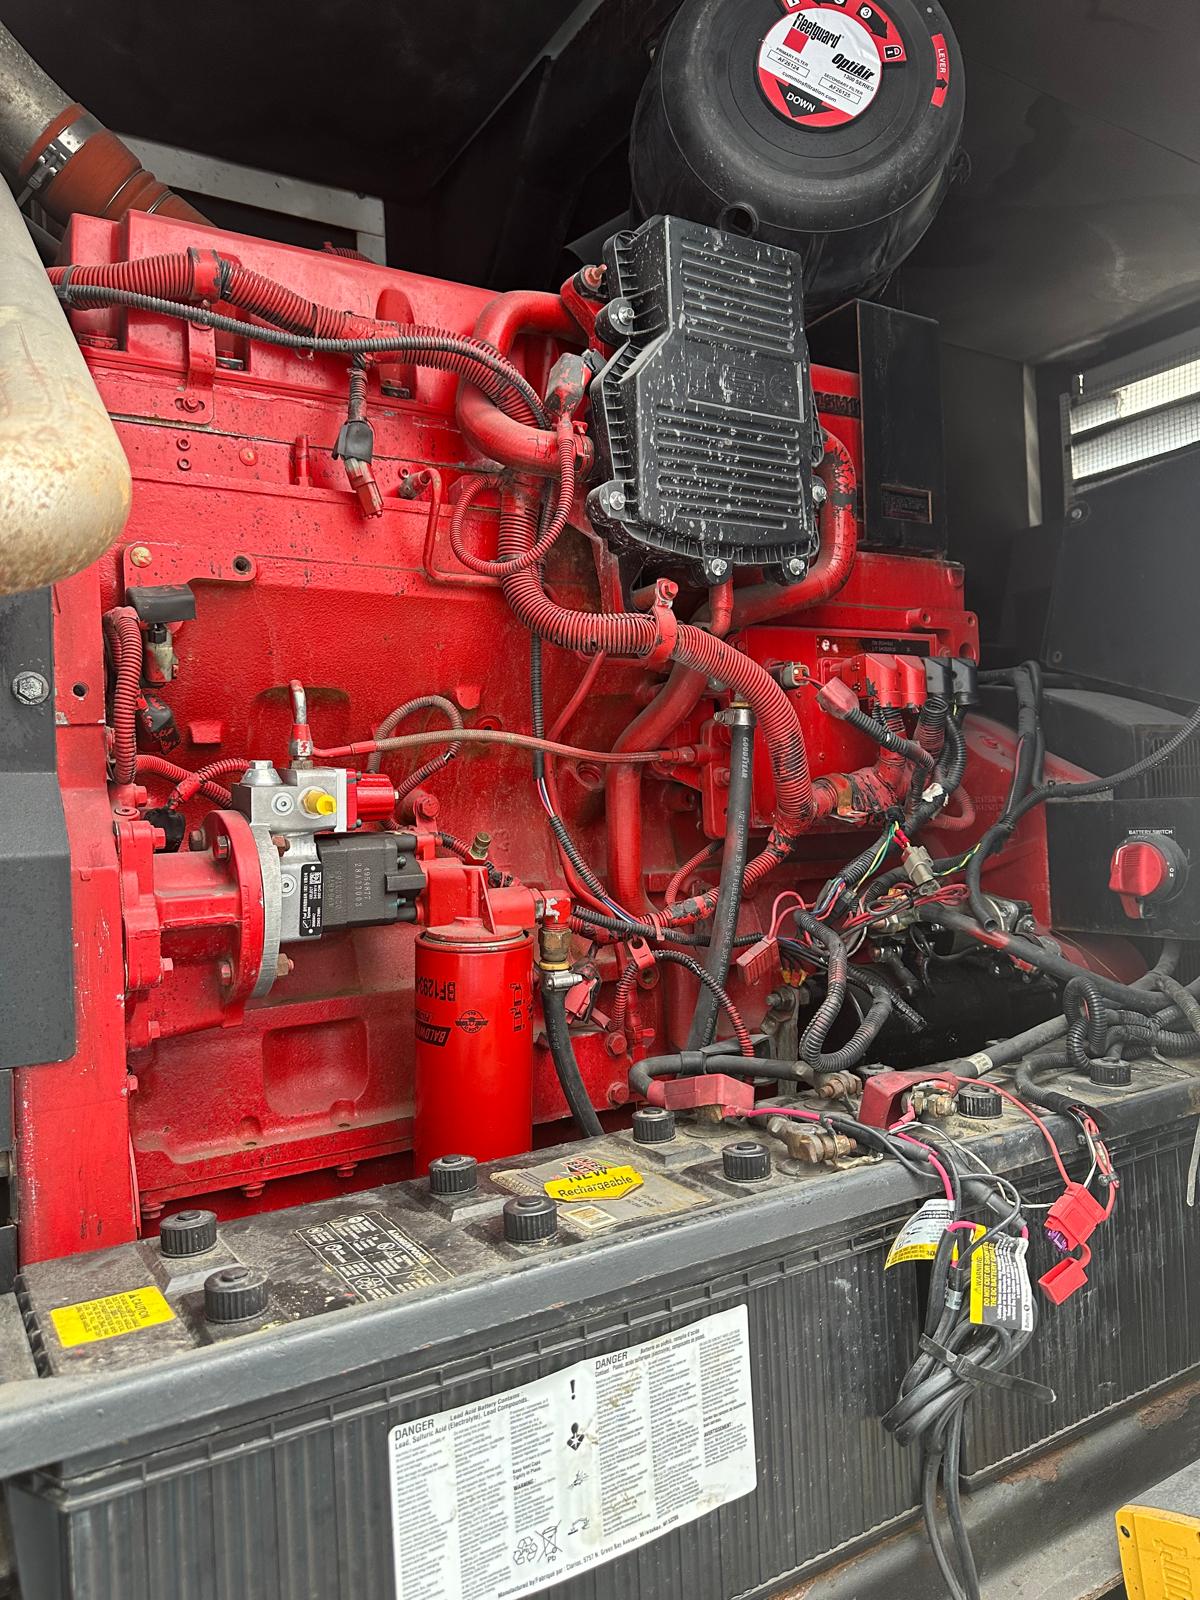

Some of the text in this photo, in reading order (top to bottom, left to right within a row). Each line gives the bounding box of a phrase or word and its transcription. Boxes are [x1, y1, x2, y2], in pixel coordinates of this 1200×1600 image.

[792, 13, 841, 49] Fleetguard
[776, 47, 808, 67] PRIMARY FILTER
[777, 57, 799, 71] AF26124
[832, 53, 875, 80] OptiAir
[938, 48, 946, 74] LEVER
[782, 71, 837, 102] cumminsfiltration.com
[823, 73, 863, 95] SECONDARY FILTER
[828, 83, 851, 98] AF26125
[855, 79, 874, 91] SERIES
[786, 92, 816, 112] DOWN
[741, 736, 749, 778] GOODYEAR
[728, 879, 740, 927] FUEL/EMISSION
[724, 931, 733, 944] SAE
[558, 1176, 633, 1198] Rechargeable
[594, 1351, 629, 1370] DANGER
[449, 1410, 464, 1421] Lead
[463, 1405, 477, 1416] Acid
[477, 1399, 497, 1412] Battery
[393, 1418, 435, 1441] DANGER
[412, 1430, 434, 1443] Sulfuric
[434, 1425, 447, 1435] Acid
[483, 1407, 497, 1417] Lead
[546, 1554, 558, 1564] Pb
